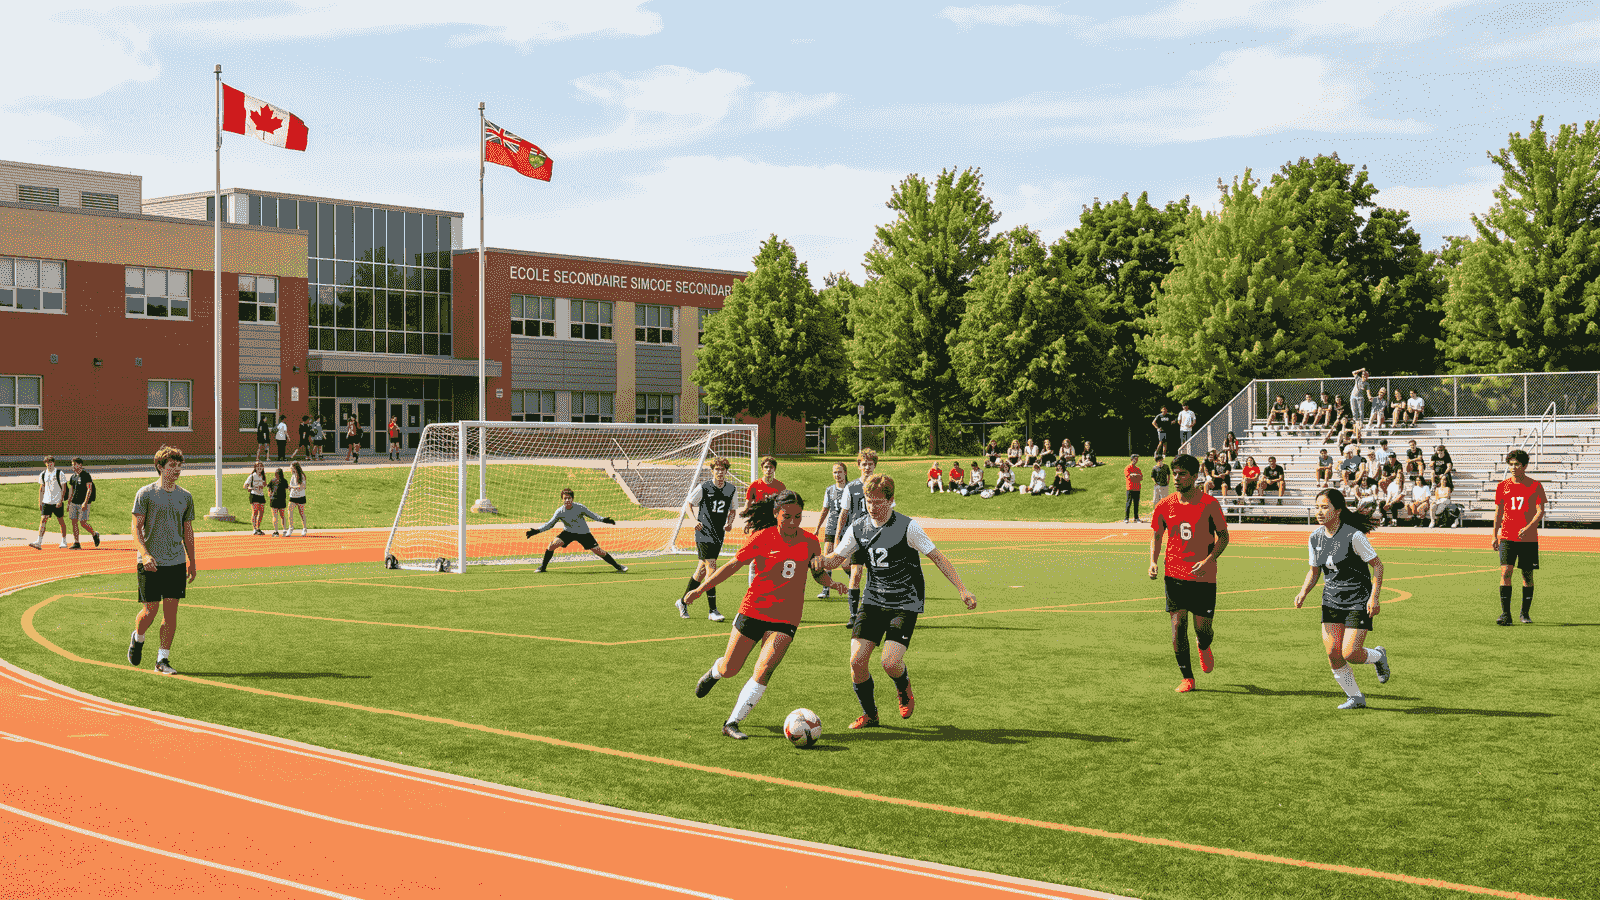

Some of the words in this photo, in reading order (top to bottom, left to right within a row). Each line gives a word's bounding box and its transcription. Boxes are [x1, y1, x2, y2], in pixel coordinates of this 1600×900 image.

[510, 266, 549, 282] ECOLE
[554, 270, 628, 289] SECONDAIRE
[631, 277, 672, 292] SIMCOE
[675, 281, 732, 296] SECONDAR
[712, 500, 725, 513] 12
[1510, 497, 1524, 510] 17
[1180, 522, 1192, 540] 6
[868, 548, 889, 567] 12
[782, 560, 796, 579] 8
